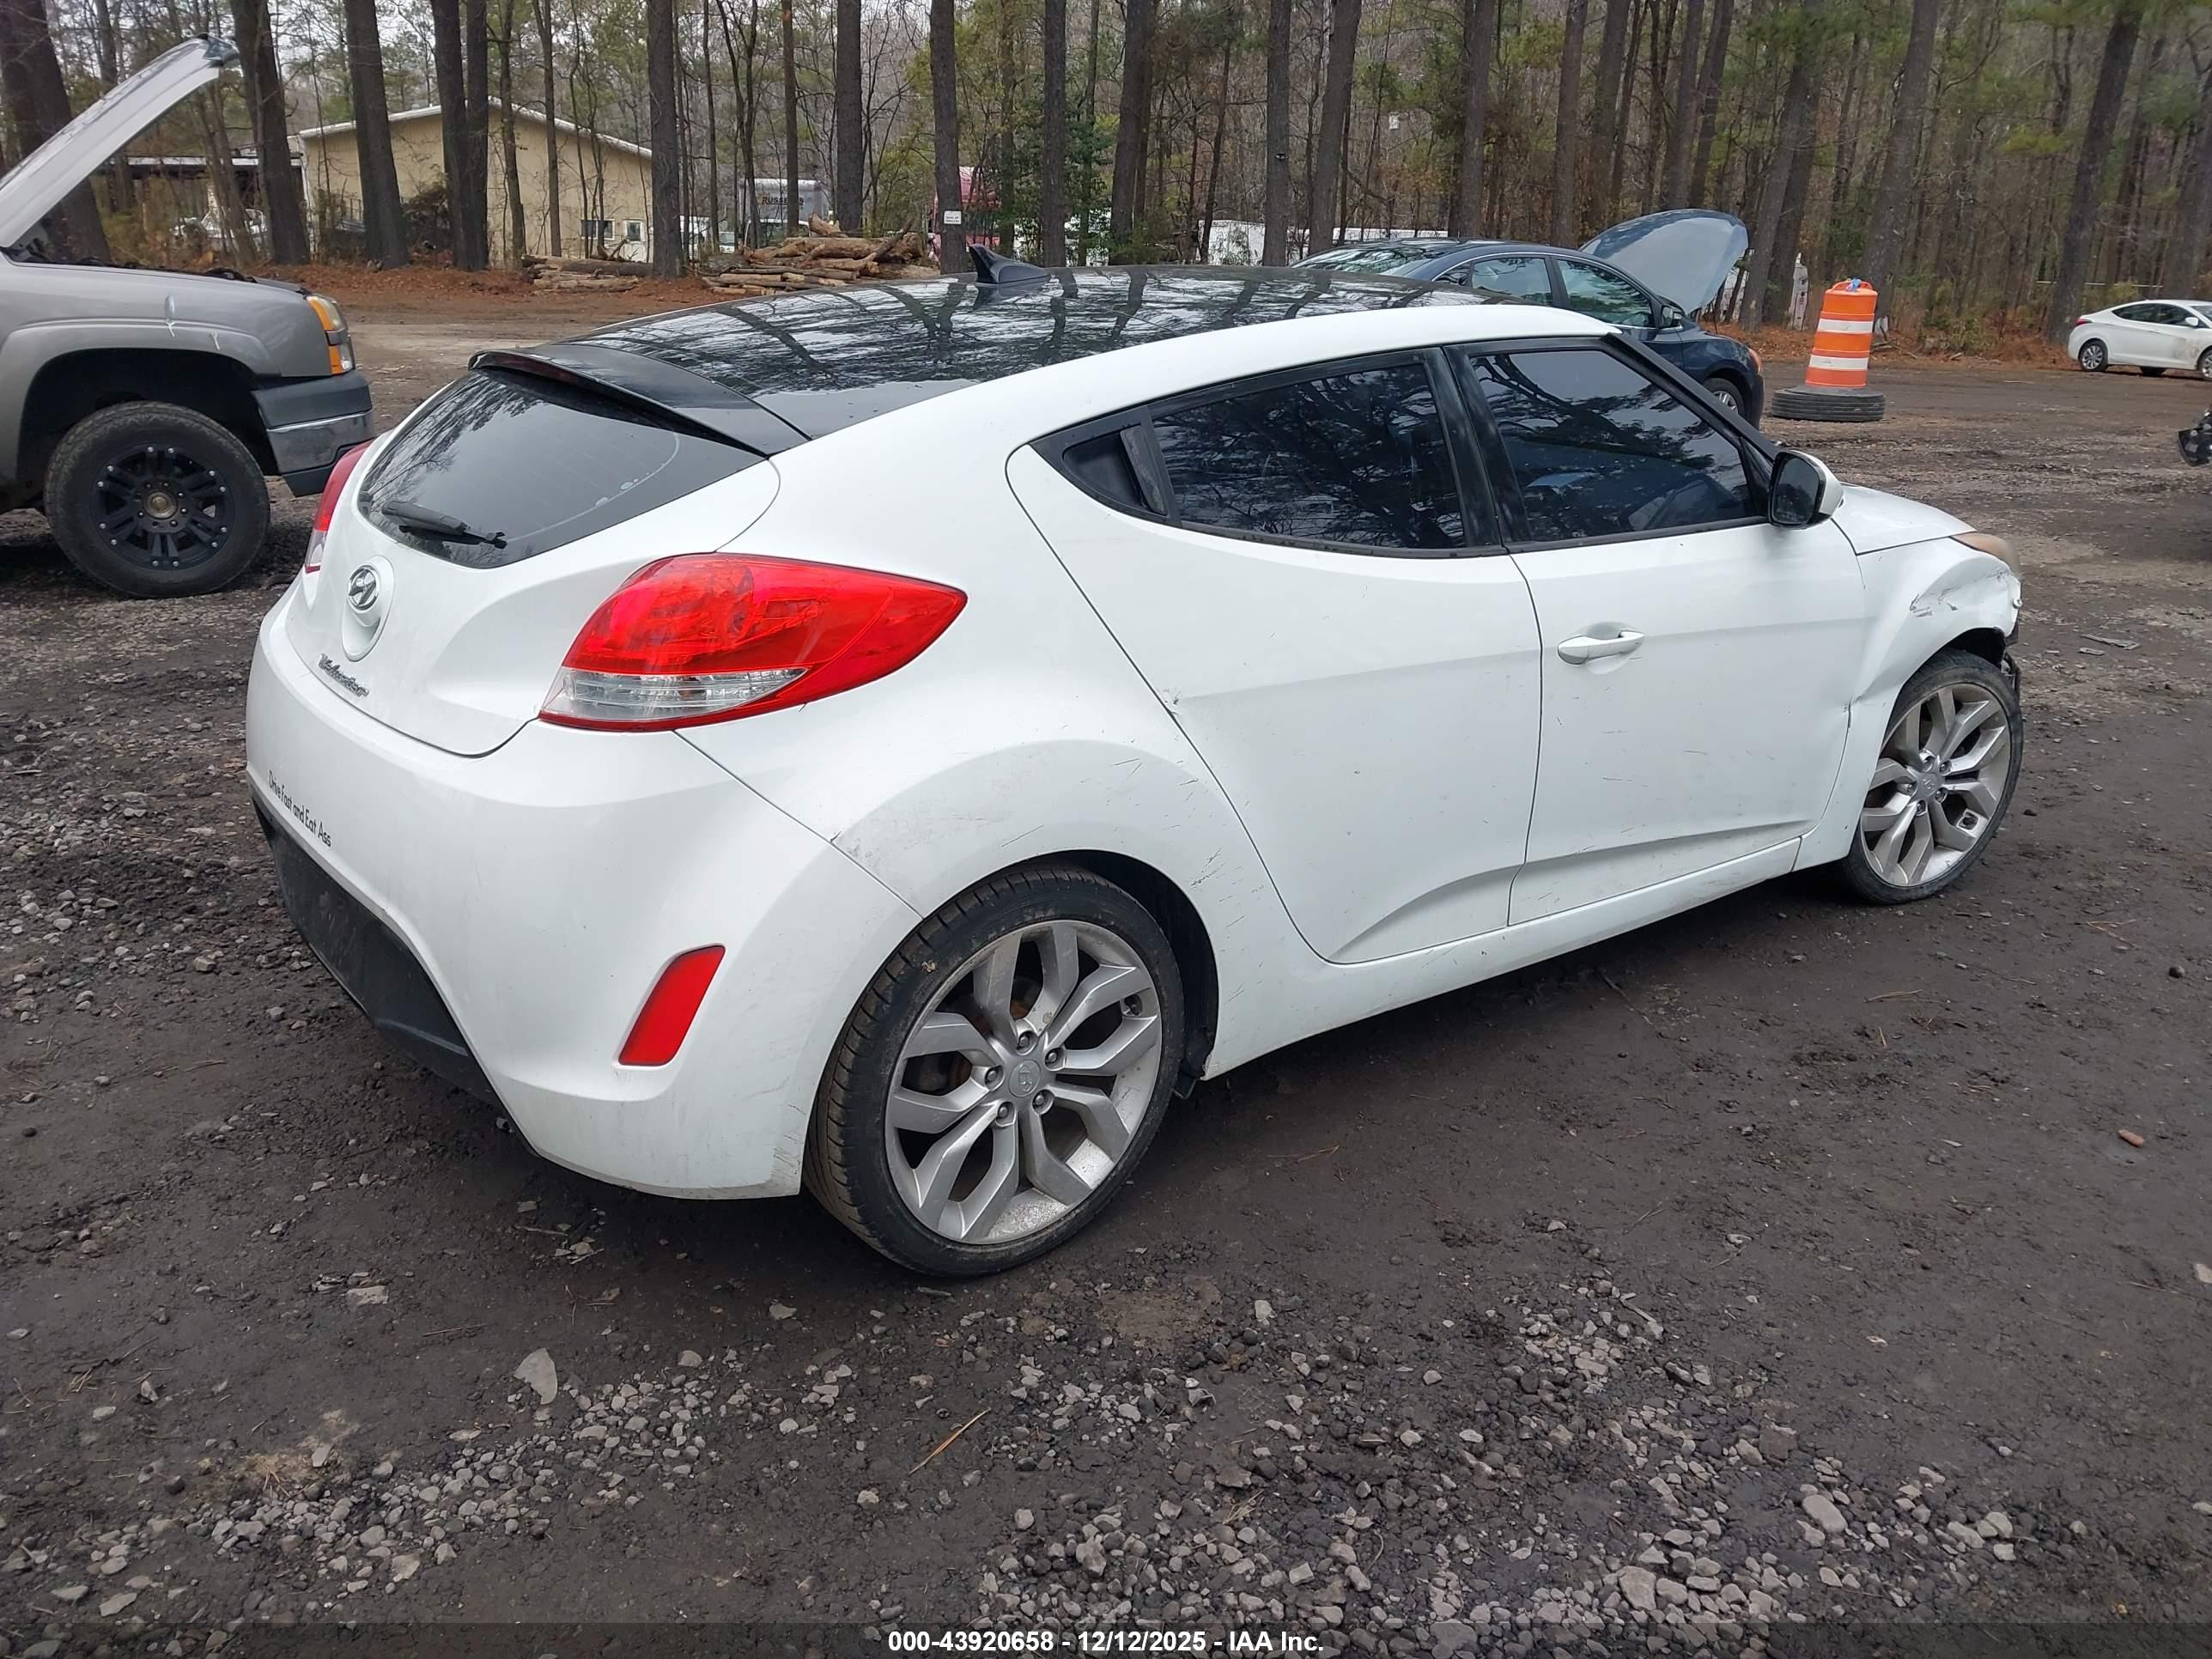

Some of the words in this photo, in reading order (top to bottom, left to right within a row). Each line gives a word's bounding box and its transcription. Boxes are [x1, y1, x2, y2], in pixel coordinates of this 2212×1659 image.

[762, 196, 805, 205] RUSSES
[269, 769, 281, 799] Drive
[293, 804, 304, 823] and
[305, 808, 316, 836] Eat
[318, 820, 331, 847] Ass
